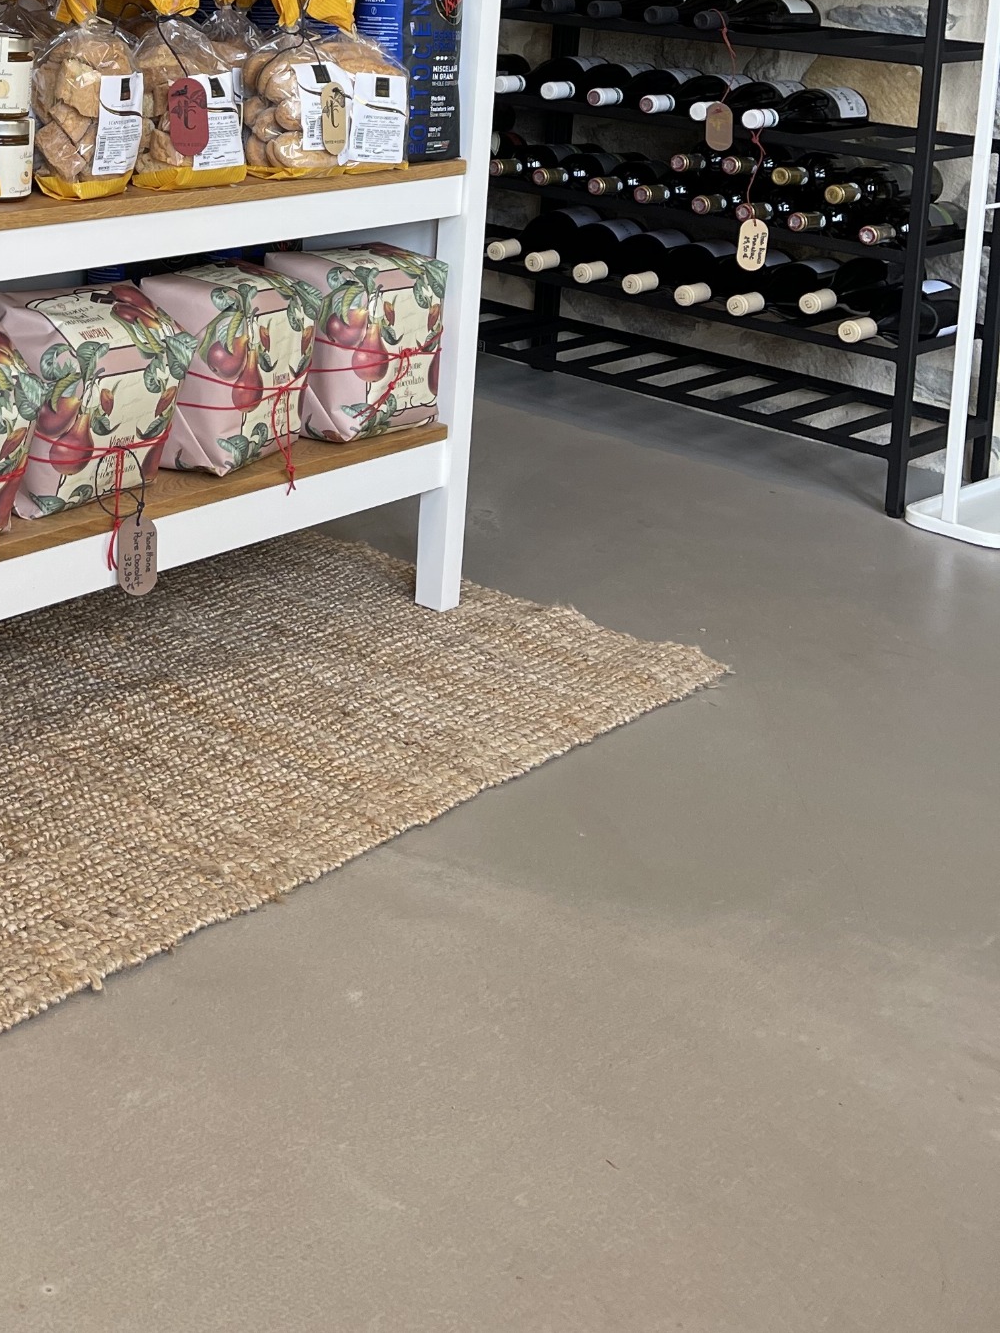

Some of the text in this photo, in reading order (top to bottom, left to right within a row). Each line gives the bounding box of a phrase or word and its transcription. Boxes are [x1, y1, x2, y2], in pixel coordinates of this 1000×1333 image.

[79, 327, 114, 341] VIRGINIA
[133, 531, 142, 552] Poire
[124, 554, 135, 591] 32,90€
